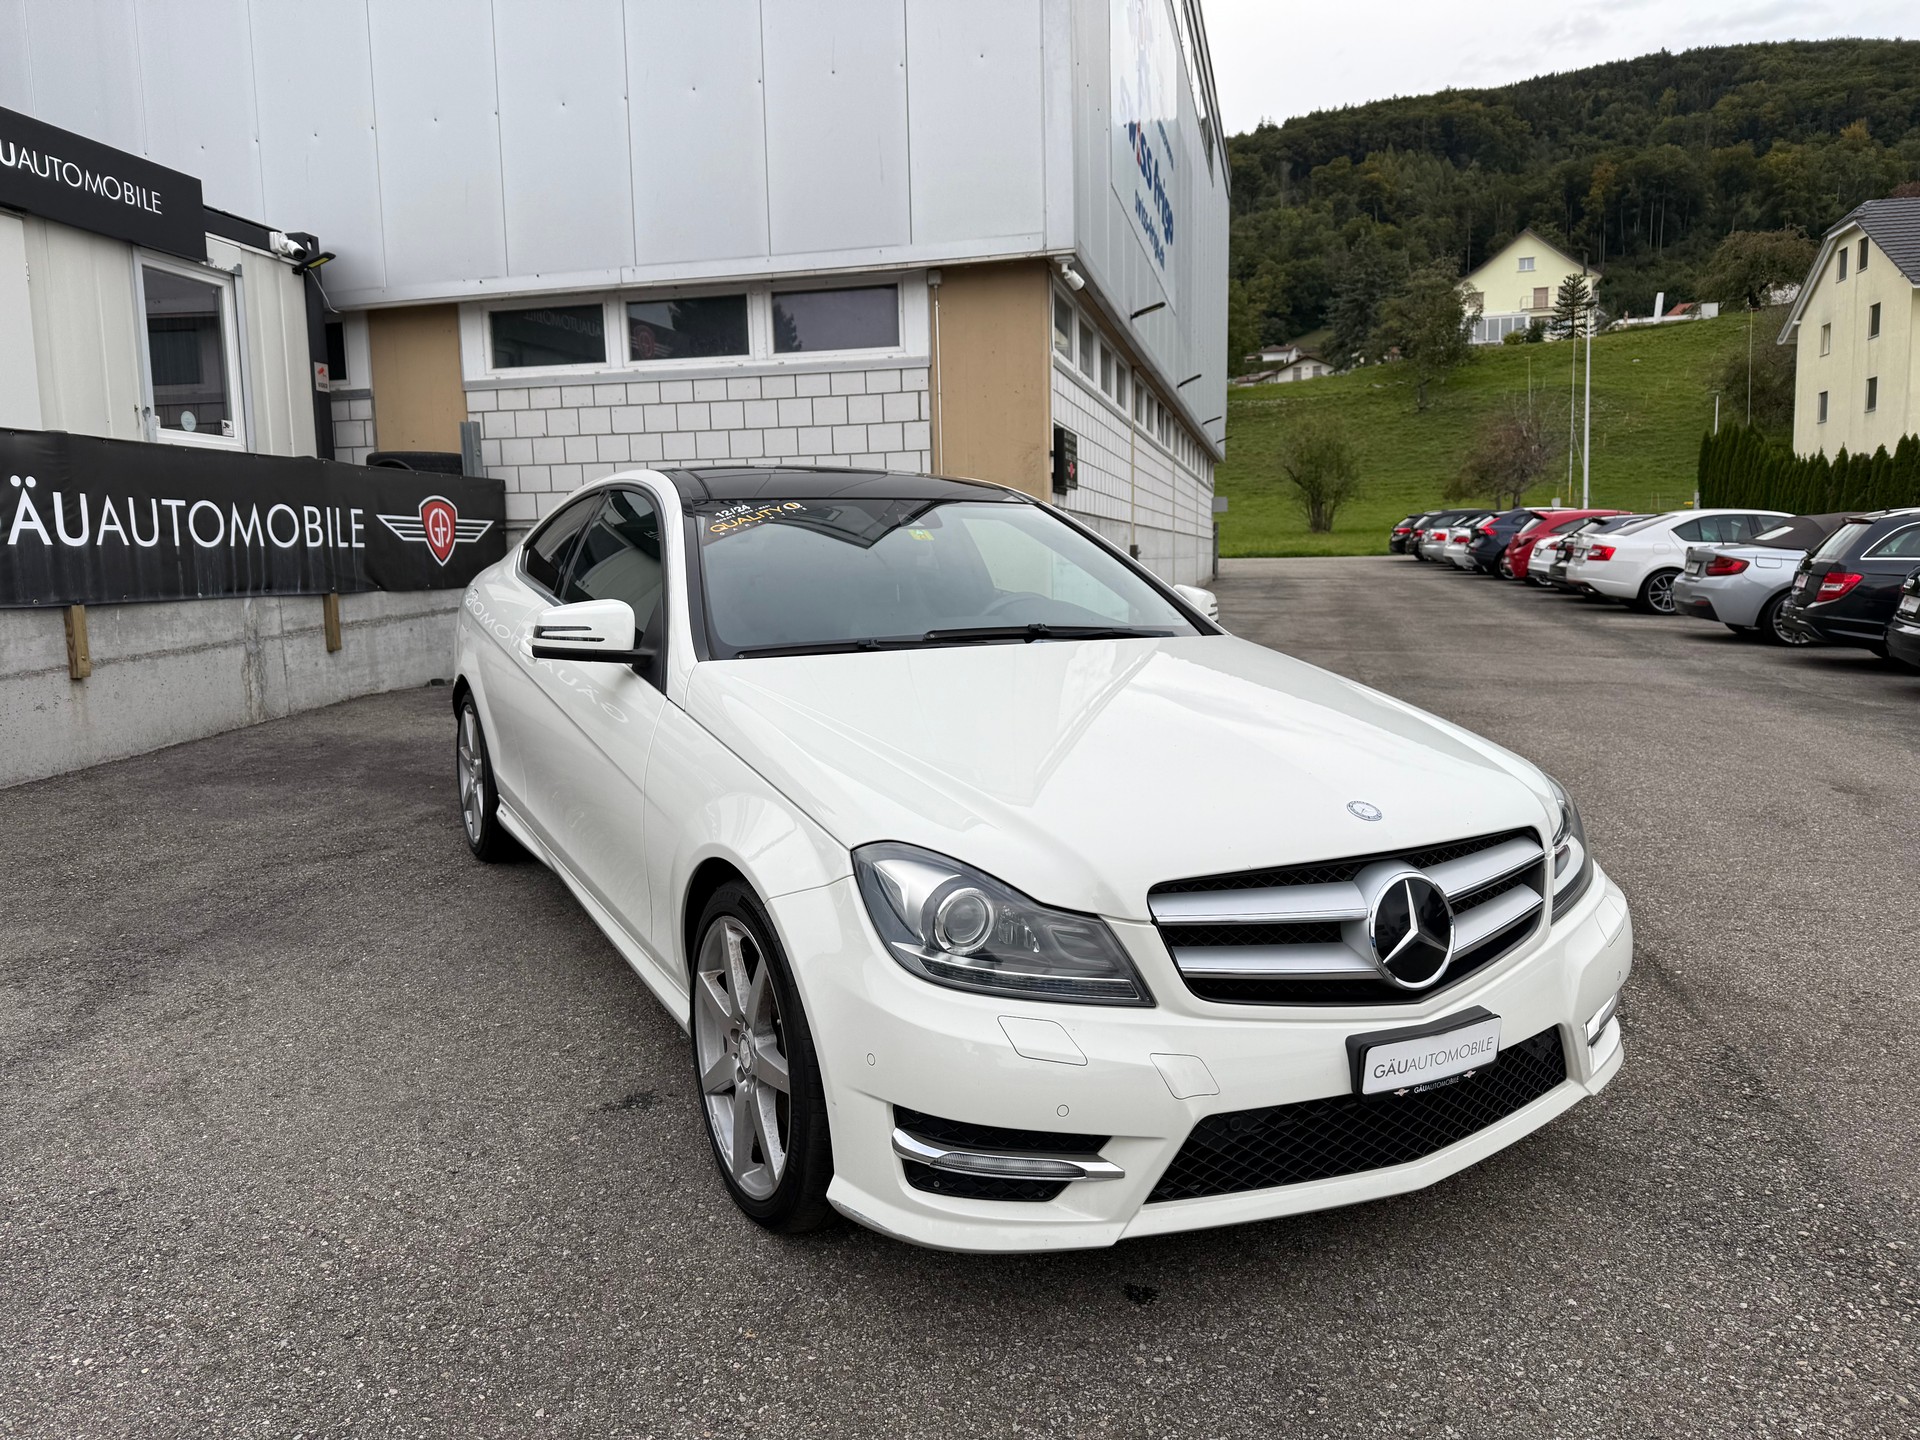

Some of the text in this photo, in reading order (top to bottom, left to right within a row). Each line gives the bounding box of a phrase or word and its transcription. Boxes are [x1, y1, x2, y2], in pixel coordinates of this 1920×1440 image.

[0, 139, 162, 215] UAUTOMOBILE
[7, 475, 365, 548] ÄUAUTOMOBILE
[710, 506, 783, 532] QUALITY
[714, 504, 751, 518] 12/24
[1373, 1036, 1494, 1079] GÄUAUTOMOBILE
